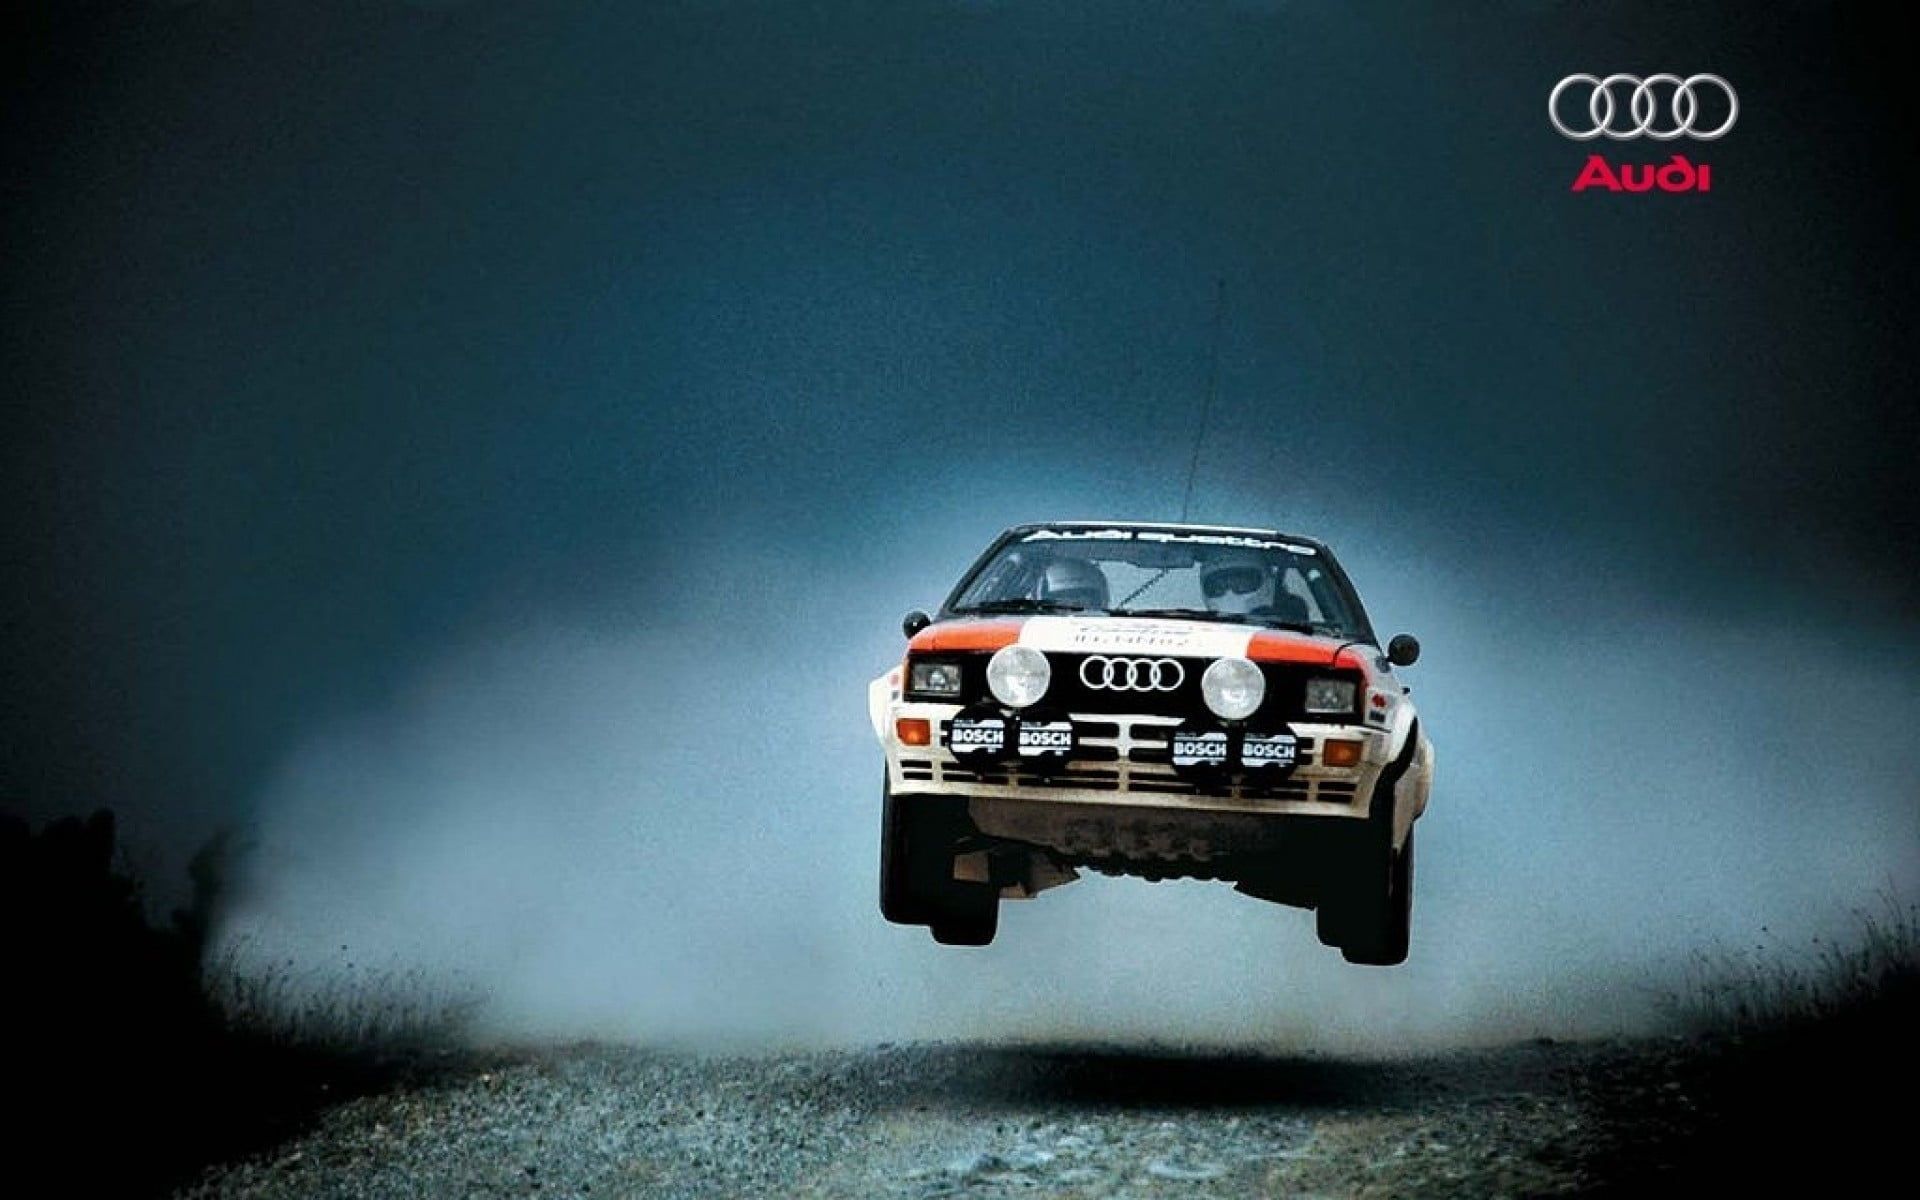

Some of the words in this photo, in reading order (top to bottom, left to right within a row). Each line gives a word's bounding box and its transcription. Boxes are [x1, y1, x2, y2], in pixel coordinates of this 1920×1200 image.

[1022, 529, 1132, 542] Audi
[952, 728, 1004, 744] BOSCH
[1019, 732, 1071, 746] BOSCH
[1174, 741, 1227, 756] BOSCH
[1243, 743, 1295, 758] BOSCH
